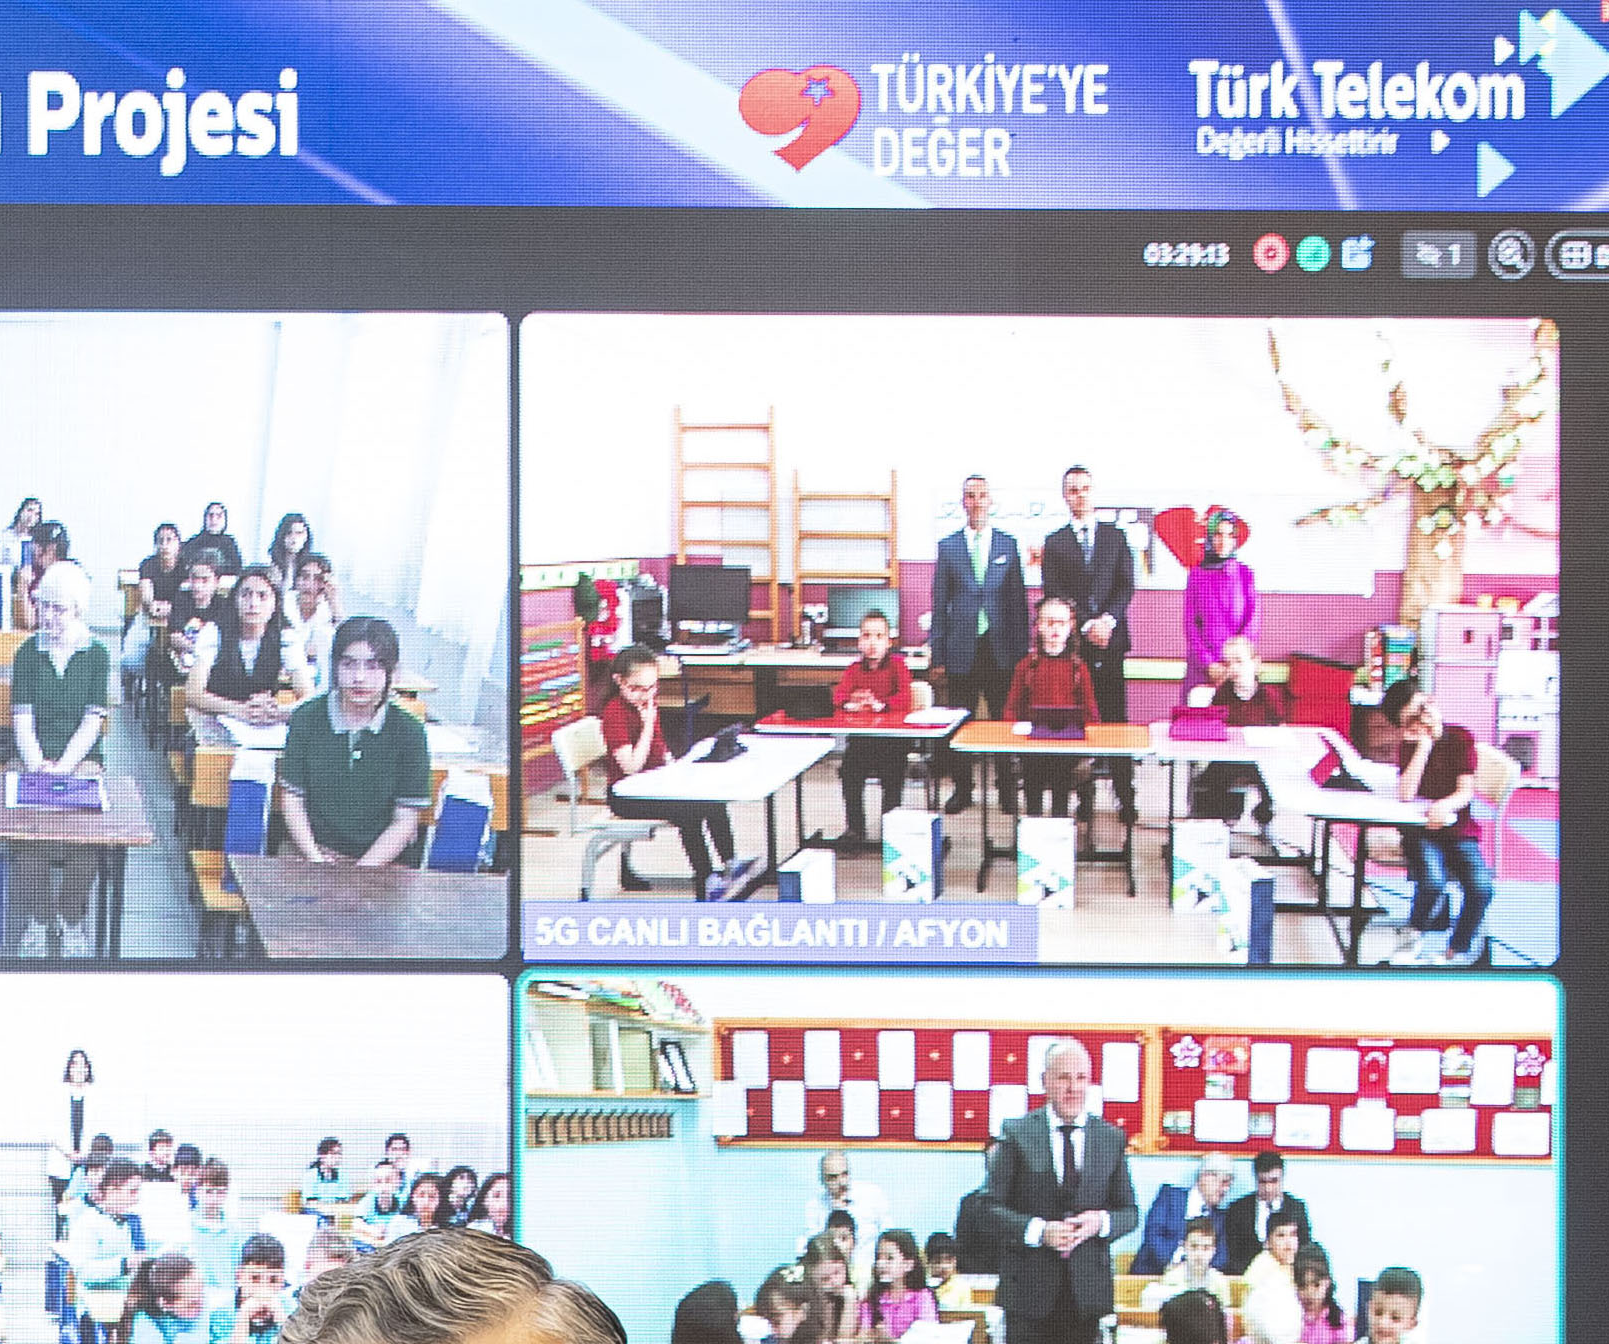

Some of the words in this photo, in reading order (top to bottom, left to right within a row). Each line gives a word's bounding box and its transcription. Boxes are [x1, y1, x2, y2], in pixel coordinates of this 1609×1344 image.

[871, 53, 1110, 114] TÜRKİYE'YE
[1188, 60, 1300, 119] Türk
[1313, 60, 1526, 122] Telekom
[27, 67, 300, 177] Projesi
[873, 116, 1013, 177] DEĞER
[535, 917, 580, 947] 5G
[587, 917, 689, 947] CANLI
[698, 913, 869, 948] BAĞLANTI
[892, 918, 1009, 948] AFYON
